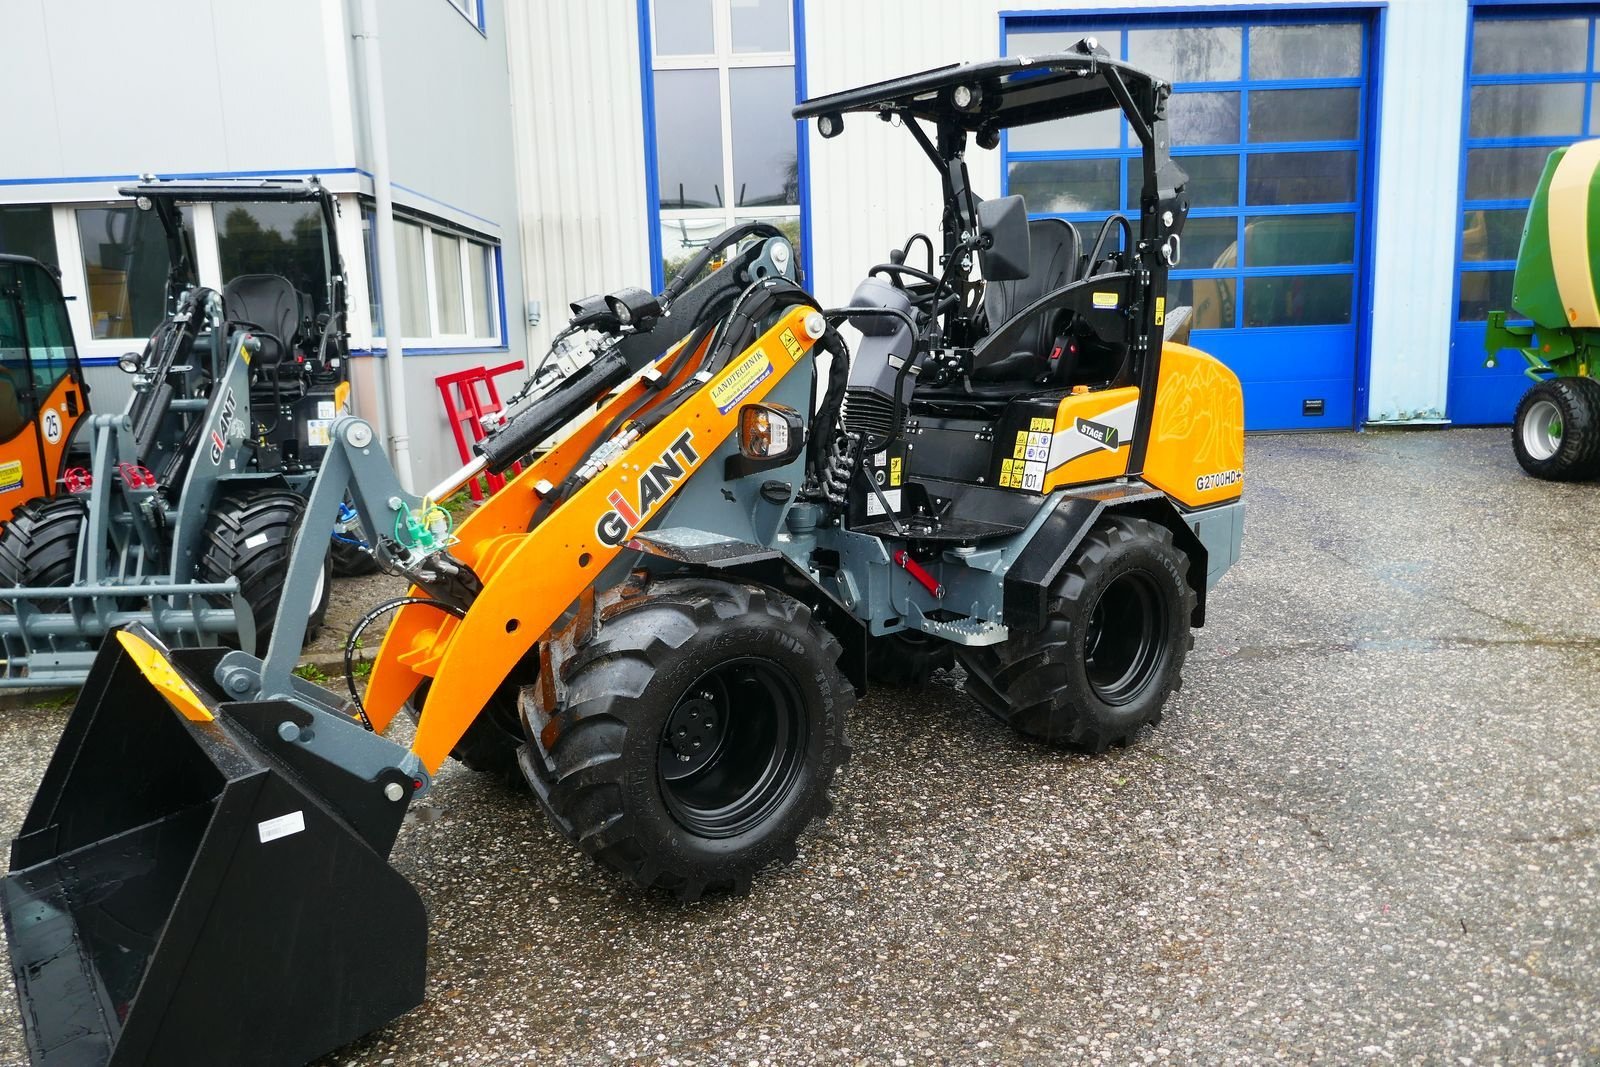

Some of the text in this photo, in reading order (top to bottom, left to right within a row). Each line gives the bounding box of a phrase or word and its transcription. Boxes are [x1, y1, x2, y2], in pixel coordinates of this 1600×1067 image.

[712, 351, 763, 399] LANDTECHNIK
[46, 415, 58, 437] 25
[1081, 424, 1117, 444] STAGE V
[1024, 473, 1037, 488] 101
[1196, 470, 1242, 491] G2700HD+
